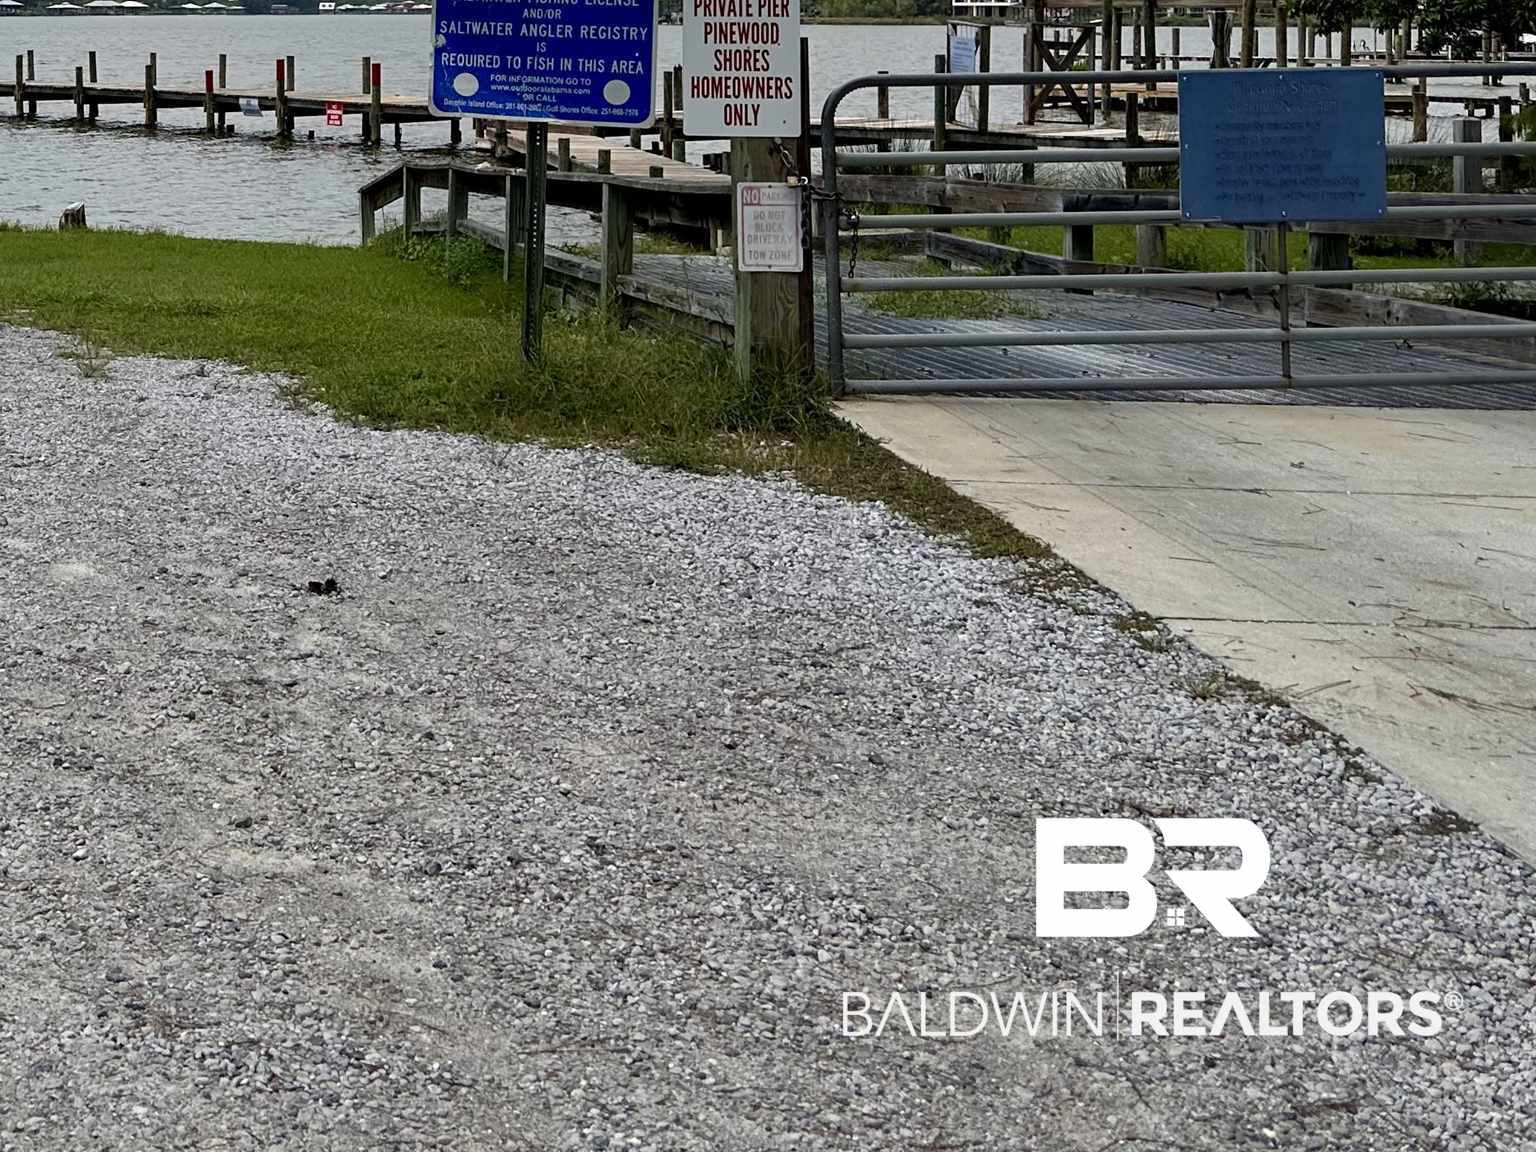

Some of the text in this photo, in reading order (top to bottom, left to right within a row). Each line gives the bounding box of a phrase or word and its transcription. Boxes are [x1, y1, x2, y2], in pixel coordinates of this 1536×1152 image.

[522, 8, 562, 19] AND/OR
[440, 21, 648, 41] SALTWATER ANGLER REGISTRY
[704, 22, 780, 45] PINEWOOD
[536, 42, 546, 53] IS
[441, 53, 644, 75] REQUIRED TO FISH IN THIS AREA
[714, 49, 770, 72] SHORES
[490, 74, 592, 86] FOR INFORMATION GO TO
[691, 76, 793, 99] HOMEOWNERS
[522, 93, 558, 102] OR CALL
[724, 103, 761, 126] ONLY
[744, 189, 759, 204] NO
